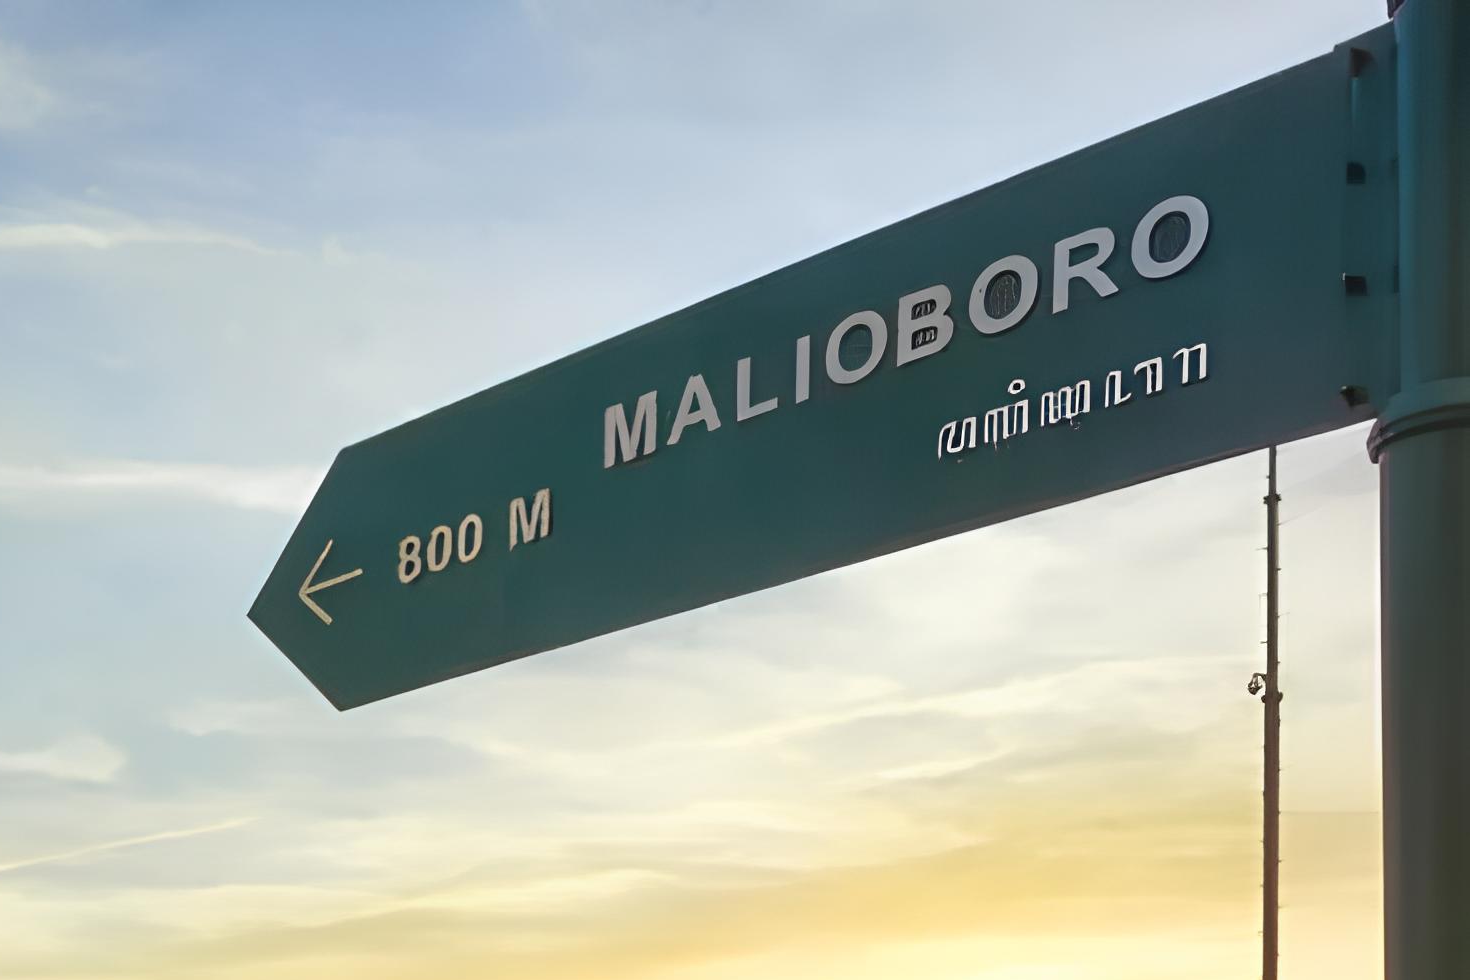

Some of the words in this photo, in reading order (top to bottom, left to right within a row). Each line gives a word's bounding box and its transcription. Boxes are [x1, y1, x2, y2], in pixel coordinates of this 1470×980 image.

[604, 195, 1210, 468] MALIOBORO
[397, 513, 483, 584] 800
[509, 487, 550, 552] M
